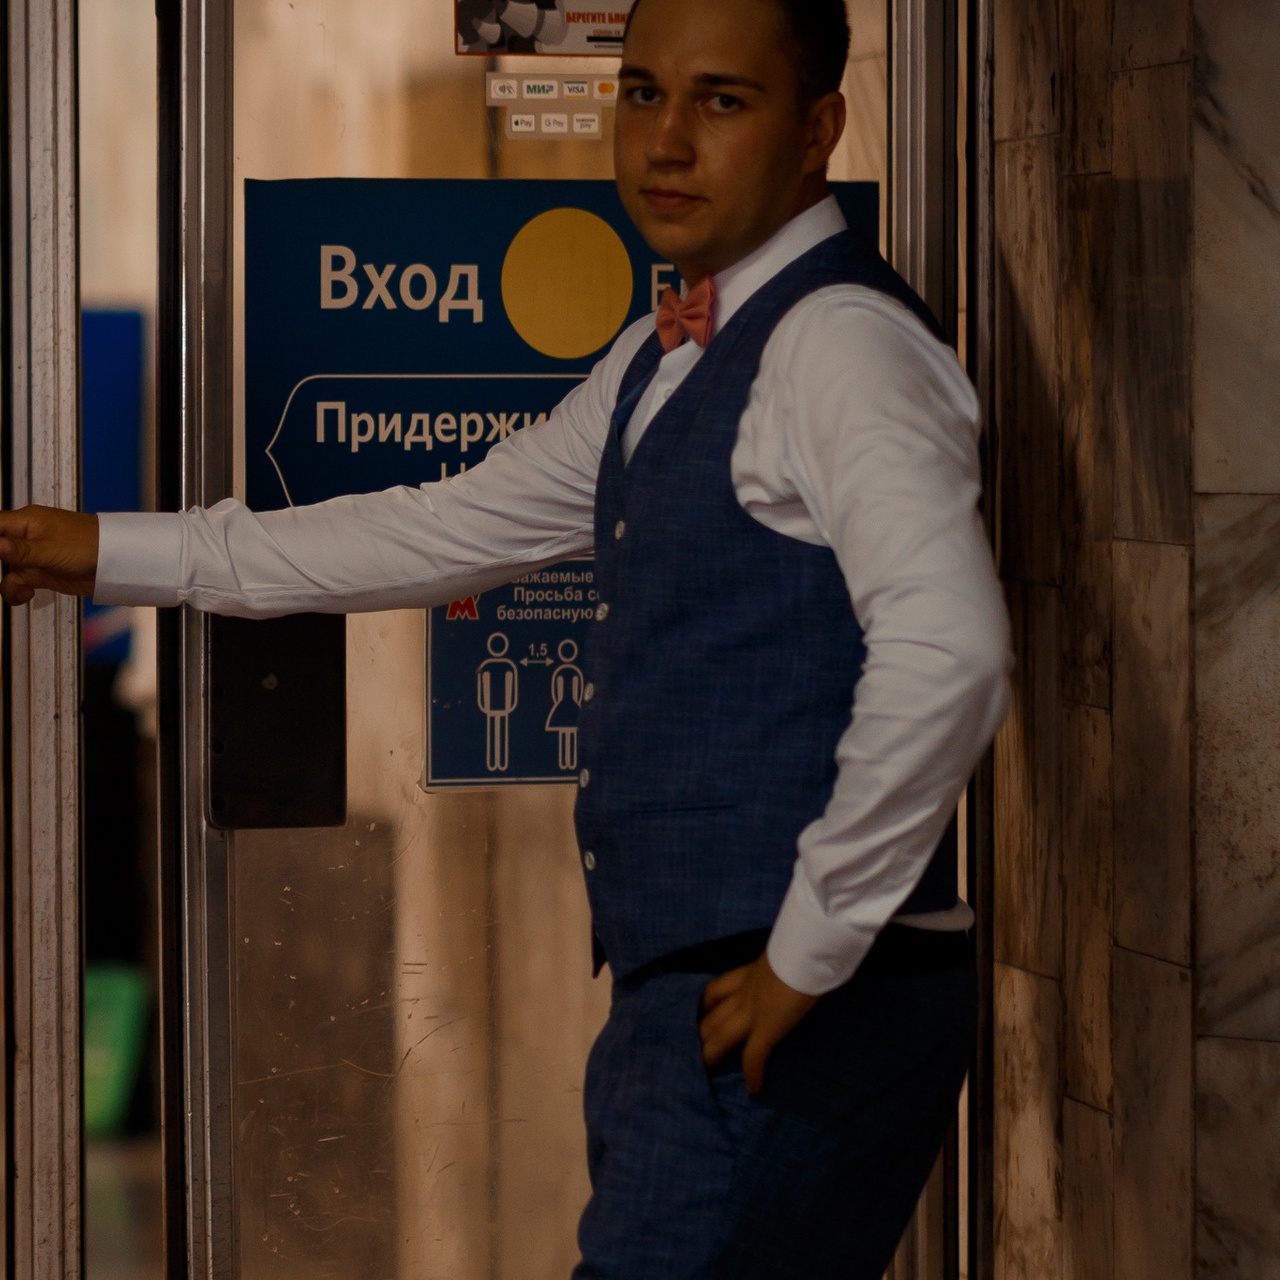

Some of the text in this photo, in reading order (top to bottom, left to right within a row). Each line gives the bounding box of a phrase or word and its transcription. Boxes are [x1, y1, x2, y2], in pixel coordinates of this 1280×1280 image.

[566, 12, 628, 24] БЕРЕГИТЕ БЛИ
[526, 84, 554, 95] МИР
[567, 86, 585, 95] VISA
[320, 244, 484, 324] Вход
[651, 263, 689, 312] E
[513, 586, 583, 606] Просьба
[497, 604, 594, 624] безопасную
[528, 642, 549, 658] 1,5
